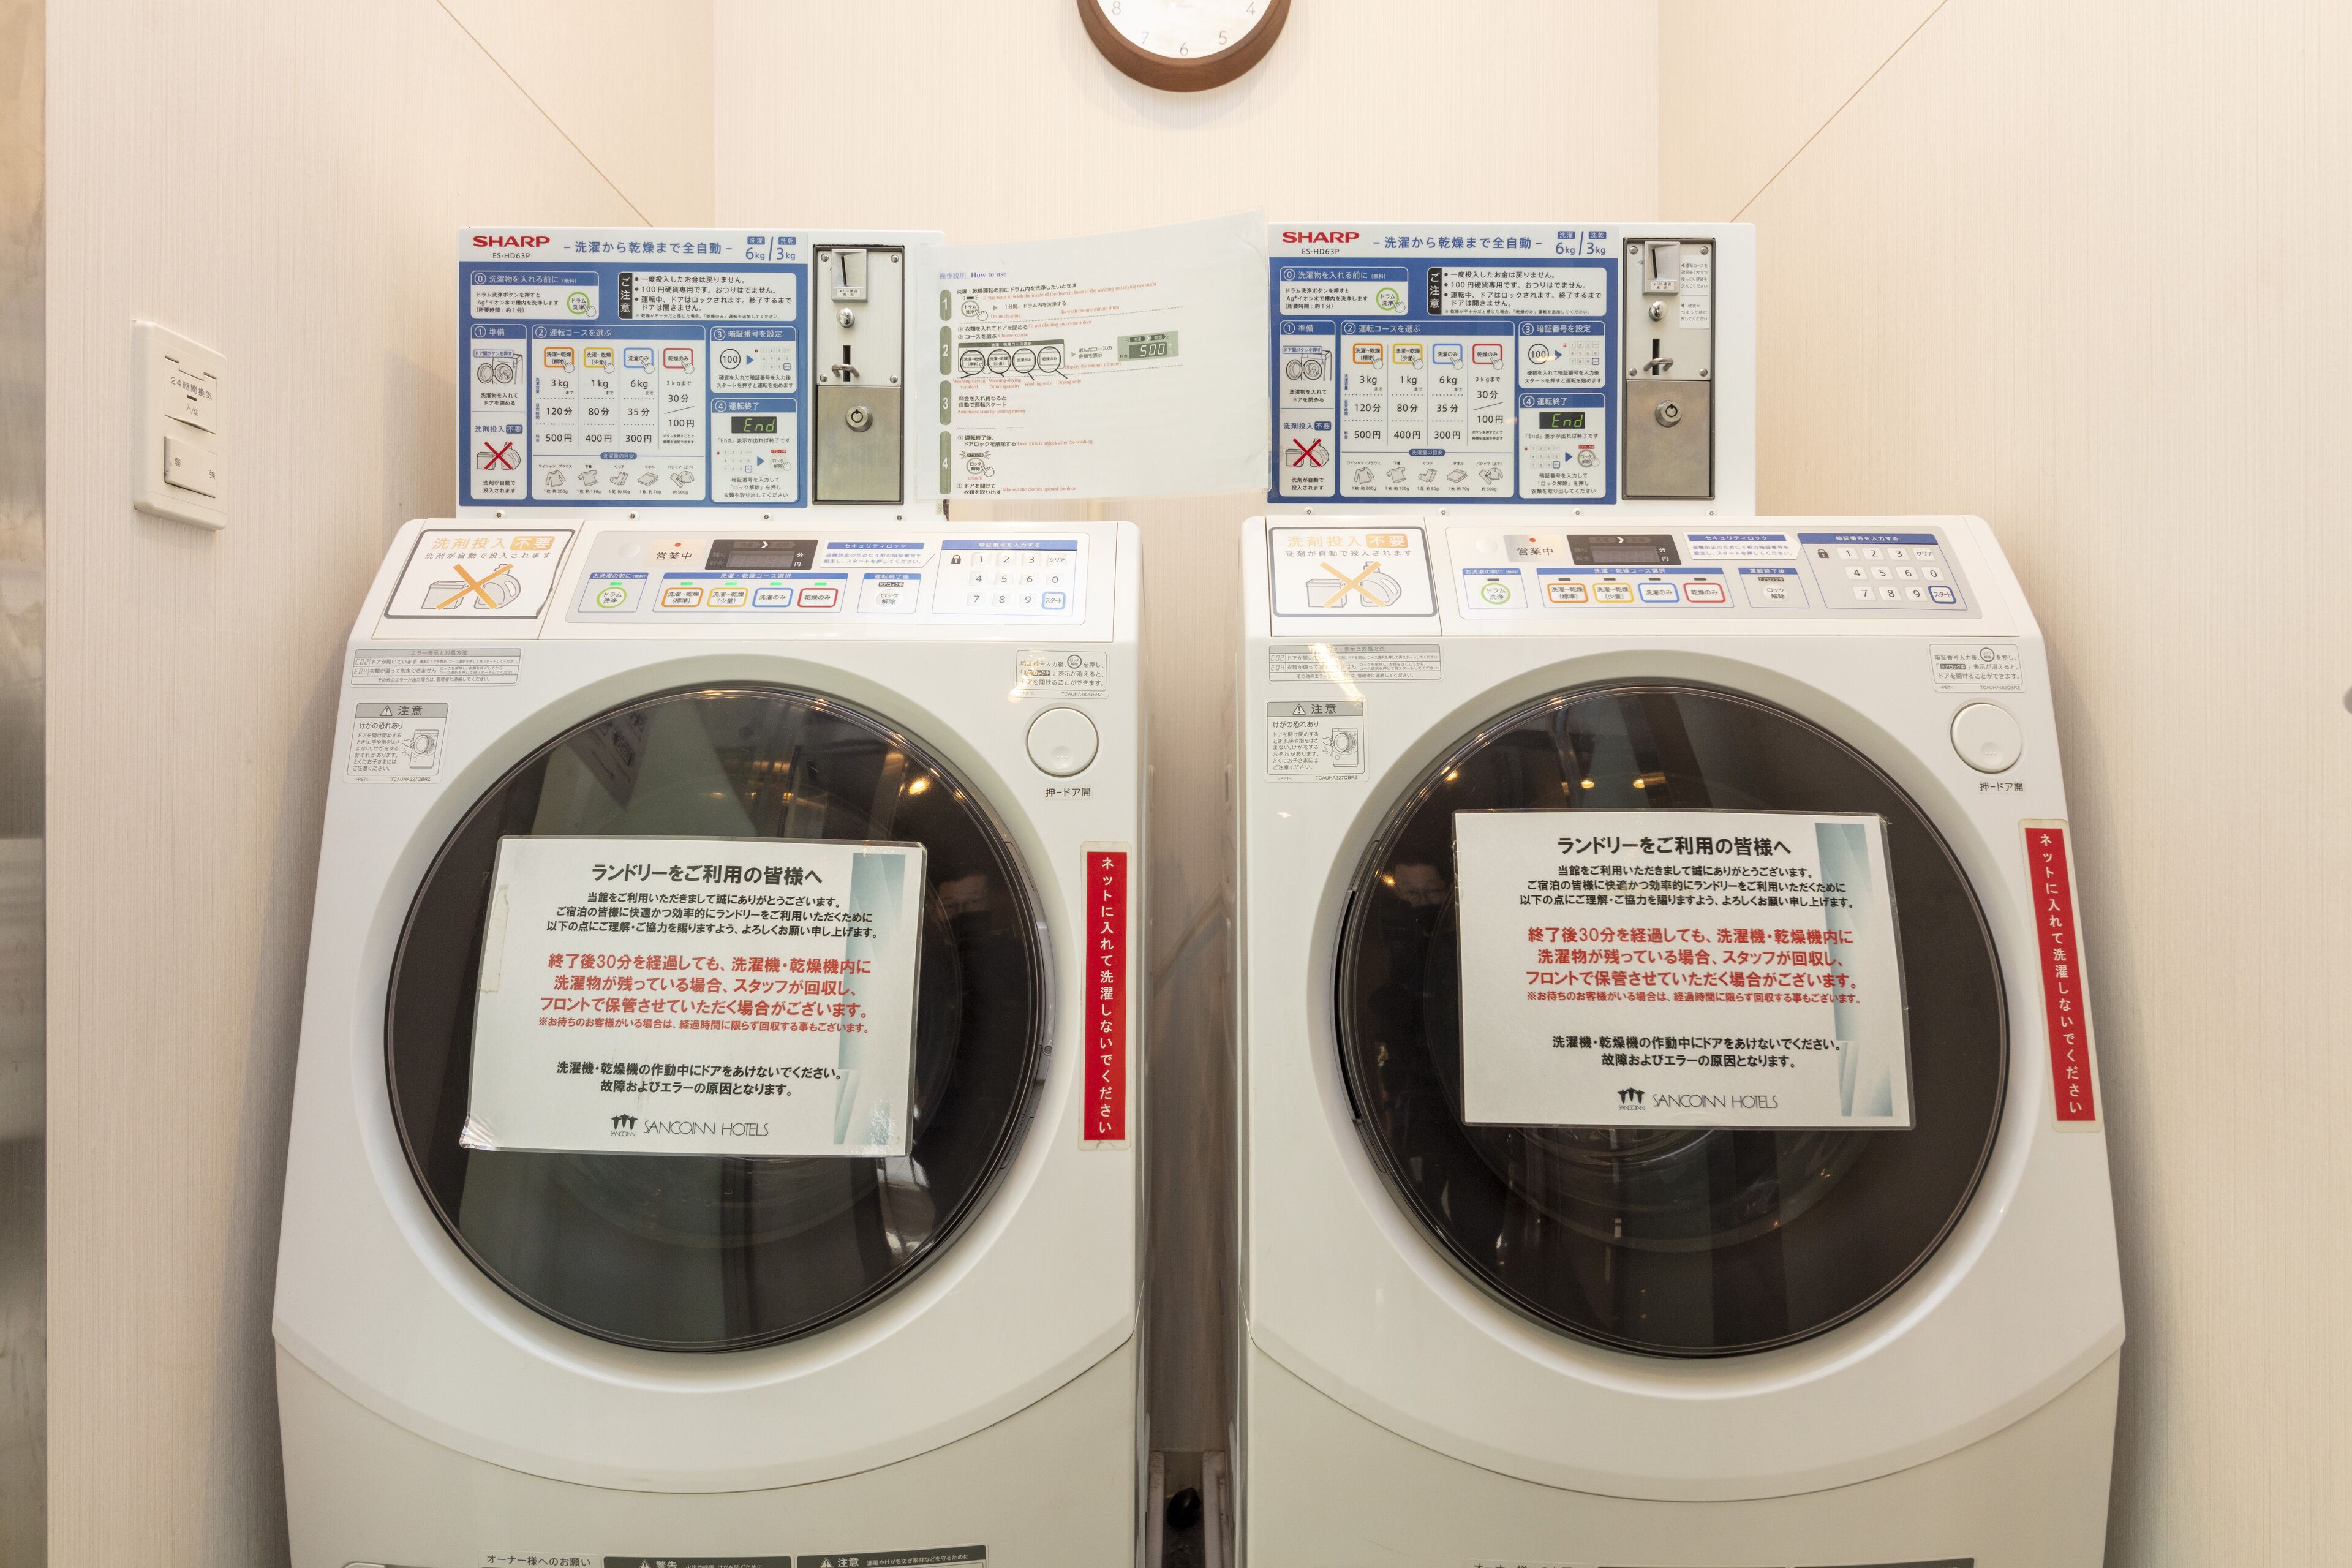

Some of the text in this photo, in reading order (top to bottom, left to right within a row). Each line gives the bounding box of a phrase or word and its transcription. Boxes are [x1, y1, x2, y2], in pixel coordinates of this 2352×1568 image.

[1112, 1, 1121, 15] 8
[1246, 2, 1255, 15] 4
[1142, 32, 1149, 45] 7
[1219, 31, 1227, 45] 5
[1180, 42, 1188, 56] 6
[473, 236, 550, 247] SHARP
[1283, 232, 1359, 243] SHARP
[746, 247, 764, 260] 6kg
[777, 247, 795, 260] 3kg
[1556, 242, 1575, 255] 6kg
[1587, 242, 1605, 255] 3kg
[489, 274, 558, 284] 洗濯物を入れる前に
[620, 277, 630, 312] ご注意
[943, 298, 947, 309] 1
[489, 327, 505, 336] 準備
[727, 330, 783, 339] 暗証番号を設定
[1358, 324, 1420, 333] 運転コースを選ぶ
[1537, 323, 1591, 333] 暗証番号を設定
[943, 344, 949, 356] 2
[1139, 342, 1166, 358] 500
[172, 375, 213, 401] 24時間換気
[729, 402, 760, 411] 運転終了
[942, 398, 949, 409] 3
[744, 418, 775, 432] End
[1552, 413, 1583, 427] End
[507, 425, 522, 434] 不要
[941, 458, 948, 469] 4
[432, 537, 553, 551] 洗剤投入 不要
[977, 540, 1042, 550] 暗証番号を入力する
[1285, 534, 1407, 549] 洗剤投入 不要
[1834, 533, 1901, 543] 暗証番号を入力する
[398, 706, 423, 715] 注意
[1311, 704, 1336, 714] 注意
[1558, 836, 1791, 856] ランドリーをご利用の皆様へ
[592, 864, 823, 886] ランドリーをご利用の皆様へ
[1558, 865, 1811, 878] 当館をご利用いただきまして誠にありがとうございます。
[1528, 880, 1845, 892] ご宿泊の皆様に快適かつ効率的にランドリーをご利用いただくために
[586, 892, 839, 908] 当館をご利用いただきまして誠にありがとうございます。
[556, 905, 872, 924] ご宿泊の皆様に快適かつ効率的にランドリーをご利用いただくために
[1528, 925, 1853, 947] 終了後30分を経過しても、洗濯機・乾燥機内に
[548, 952, 871, 975] 終了後30分を経過しても、洗濯機・乾燥機内に
[1538, 948, 1845, 968] 洗濯物が残っている場合、スタッフが回収し、
[1526, 970, 1856, 990] フロントで保管させていただく場合がございます。
[2039, 832, 2084, 1114] ネットに入れて洗濯しないでください
[554, 974, 856, 997] 洗濯物が残っている場合、スタッフが回収し、
[1099, 858, 1114, 1133] ネットに入れて洗濯しないでください
[540, 997, 870, 1020] フロントで保管させていただく場合がございます。
[1553, 1036, 1843, 1050] 洗濯機・乾燥機の作動中にドアをあけないでください。
[1602, 1054, 1797, 1068] 故障およびエラーの原因となります。
[557, 1061, 840, 1081] 洗濯機・乾燥機の作動中にドアをあけないでください。
[601, 1080, 791, 1096] 故障およびエラーの原因となります。
[1653, 1094, 1778, 1108] SANCOINN HOTELS
[644, 1121, 768, 1136] SANCOINN HOTELS
[486, 1555, 590, 1568] オーナー様へのお願い
[838, 1558, 859, 1567] 注意
